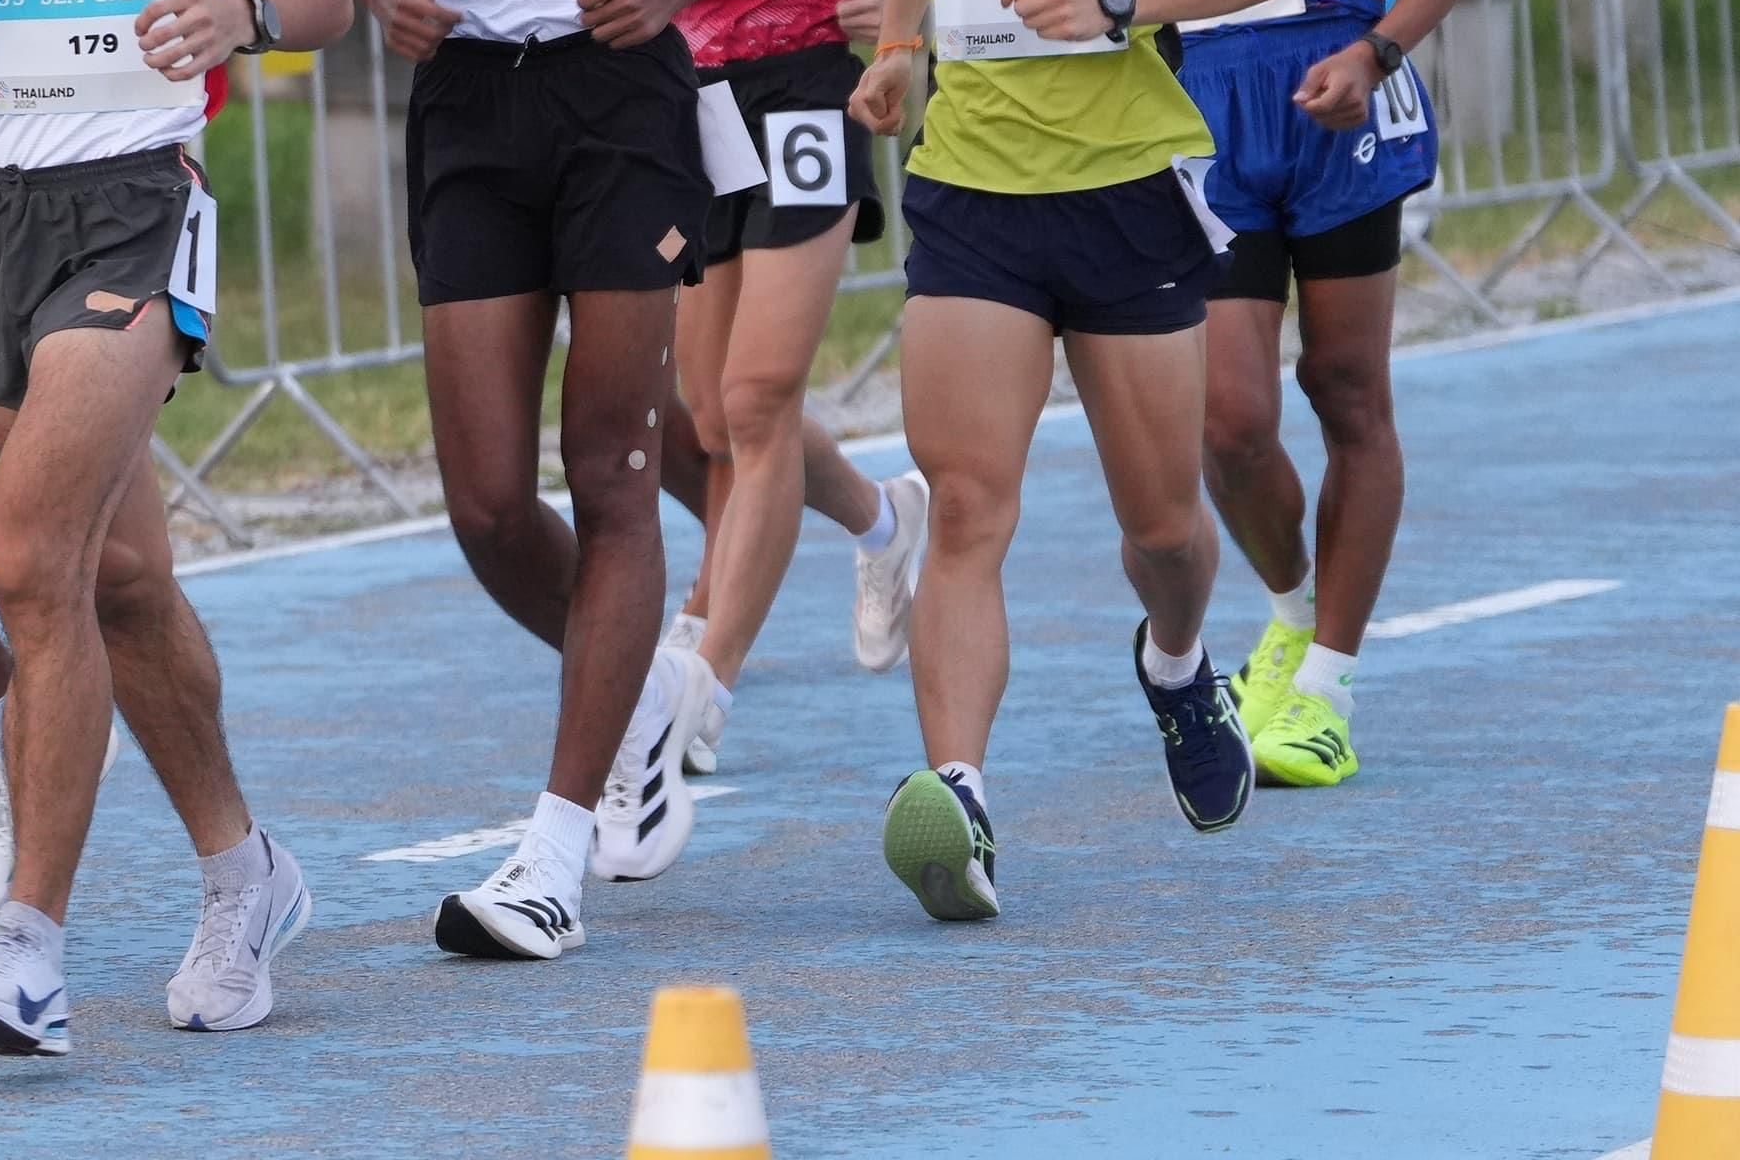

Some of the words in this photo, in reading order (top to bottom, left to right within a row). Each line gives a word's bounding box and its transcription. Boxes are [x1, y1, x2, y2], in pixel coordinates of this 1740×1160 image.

[68, 33, 119, 55] 179
[965, 33, 1016, 46] THAILAND
[12, 87, 75, 99] THAILAND
[1381, 60, 1419, 125] 10
[782, 123, 833, 192] 6
[186, 209, 201, 295] 1
